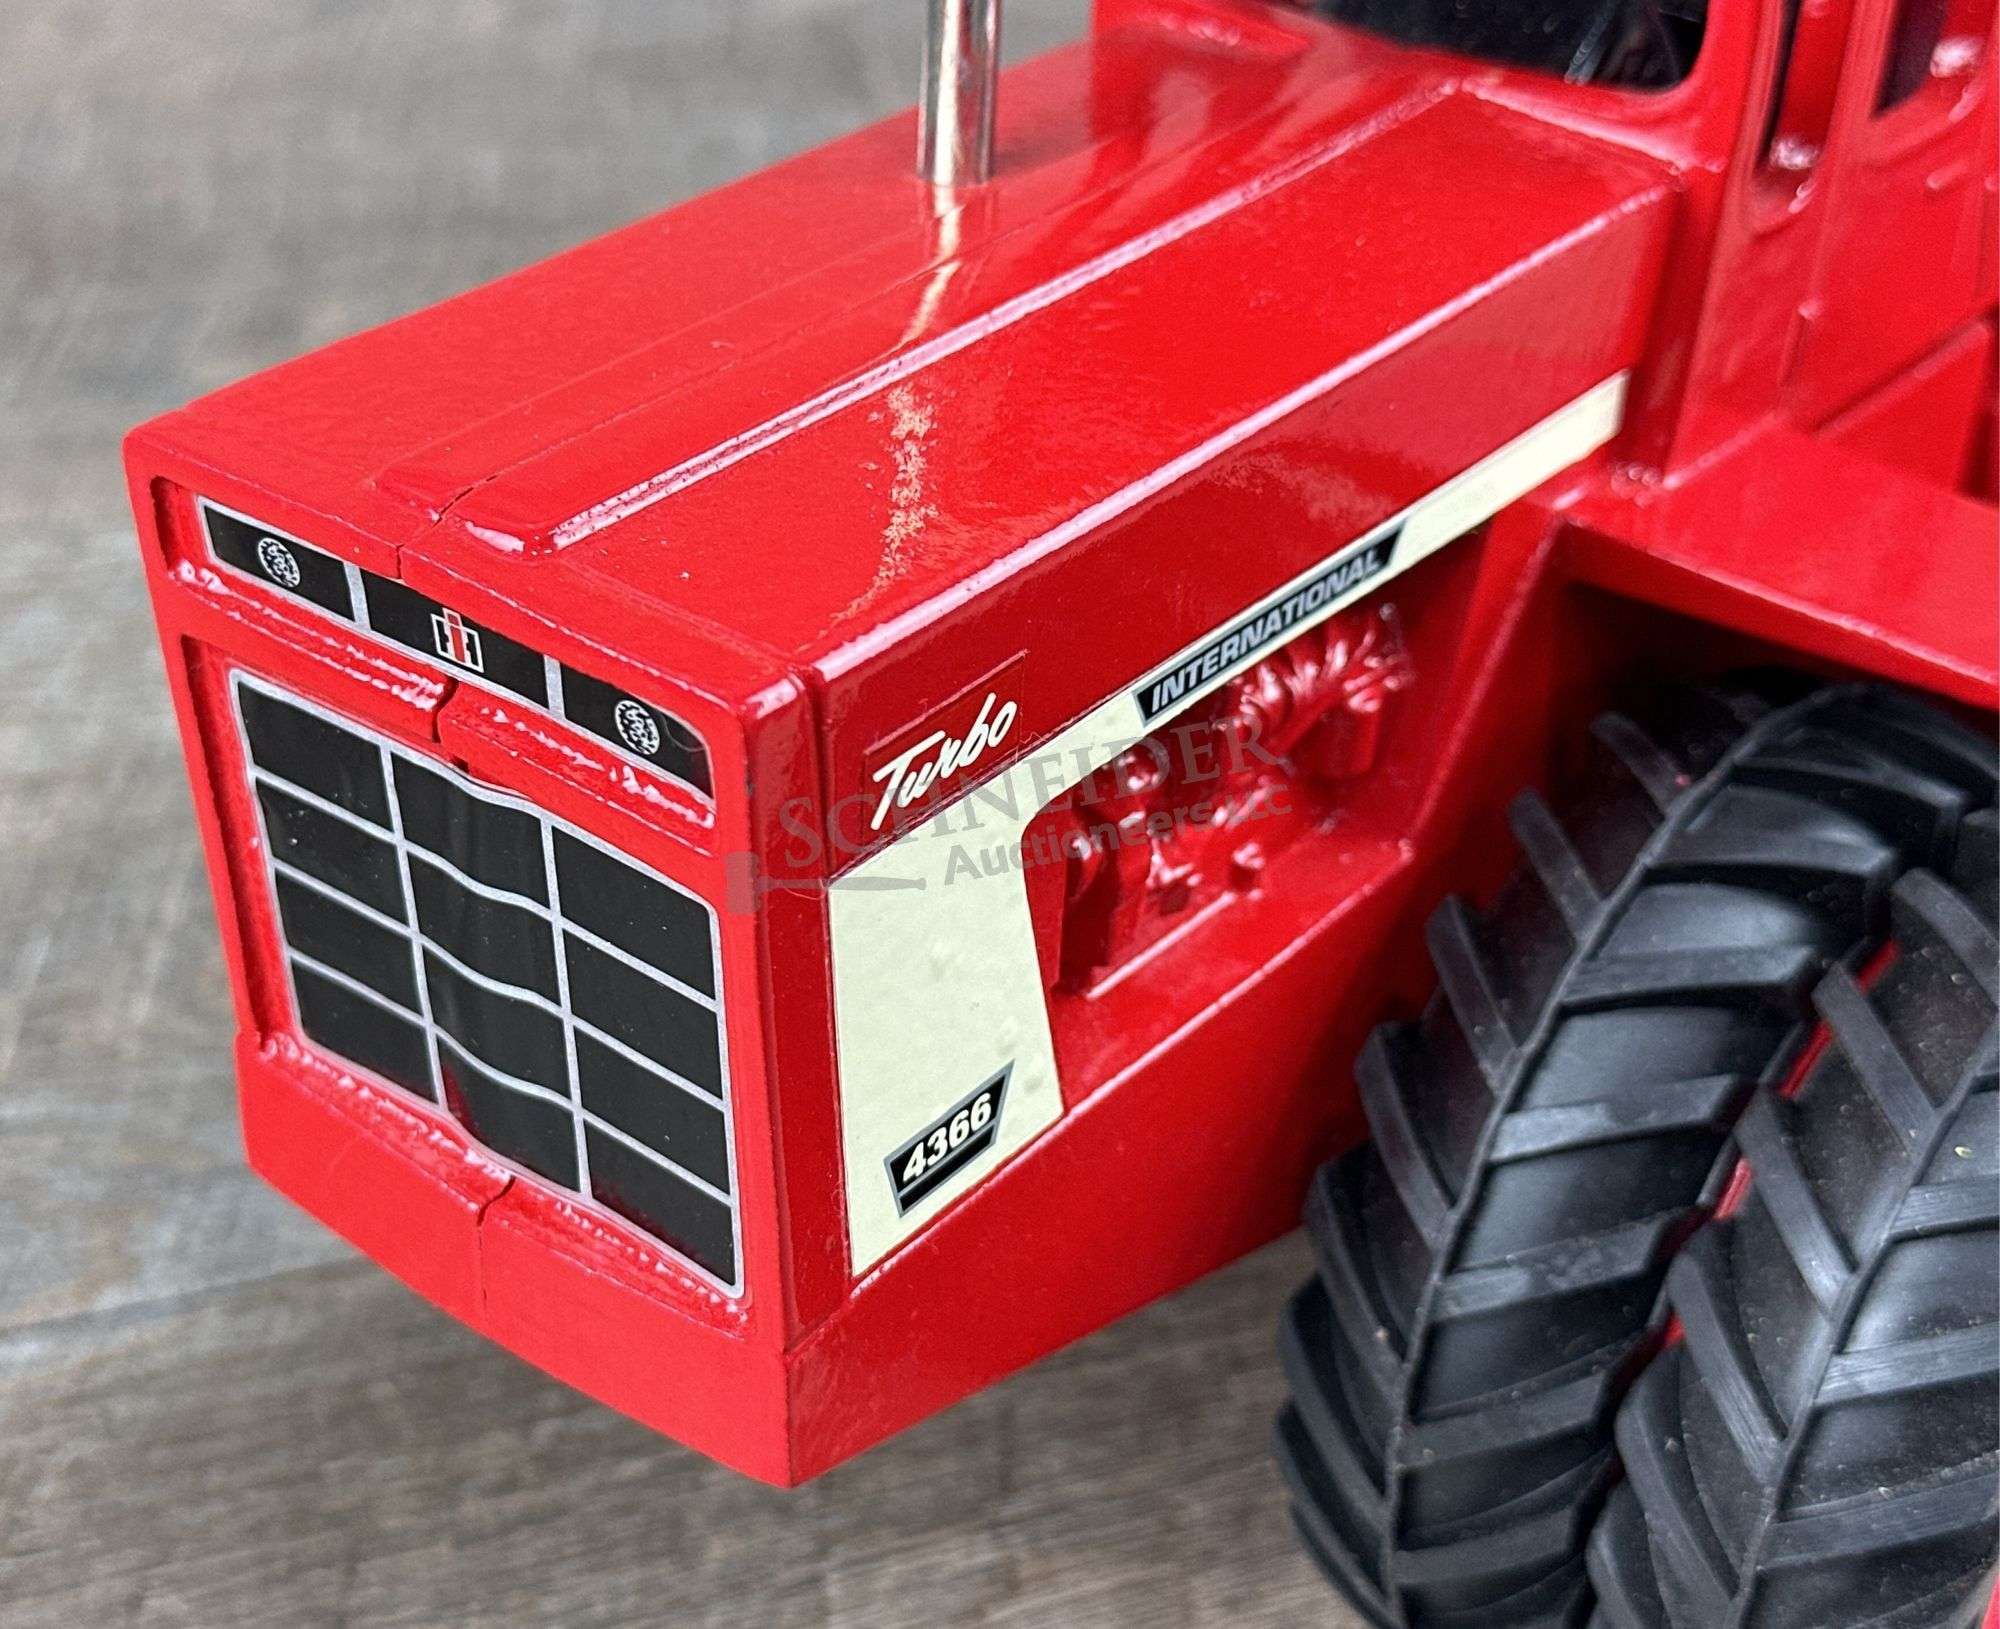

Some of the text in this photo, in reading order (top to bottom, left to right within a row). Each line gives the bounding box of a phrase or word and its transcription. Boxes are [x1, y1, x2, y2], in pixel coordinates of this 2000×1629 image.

[1151, 549, 1382, 713] INTERNATIONAL
[870, 692, 1017, 830] Turbo
[902, 1092, 992, 1183] 4366
